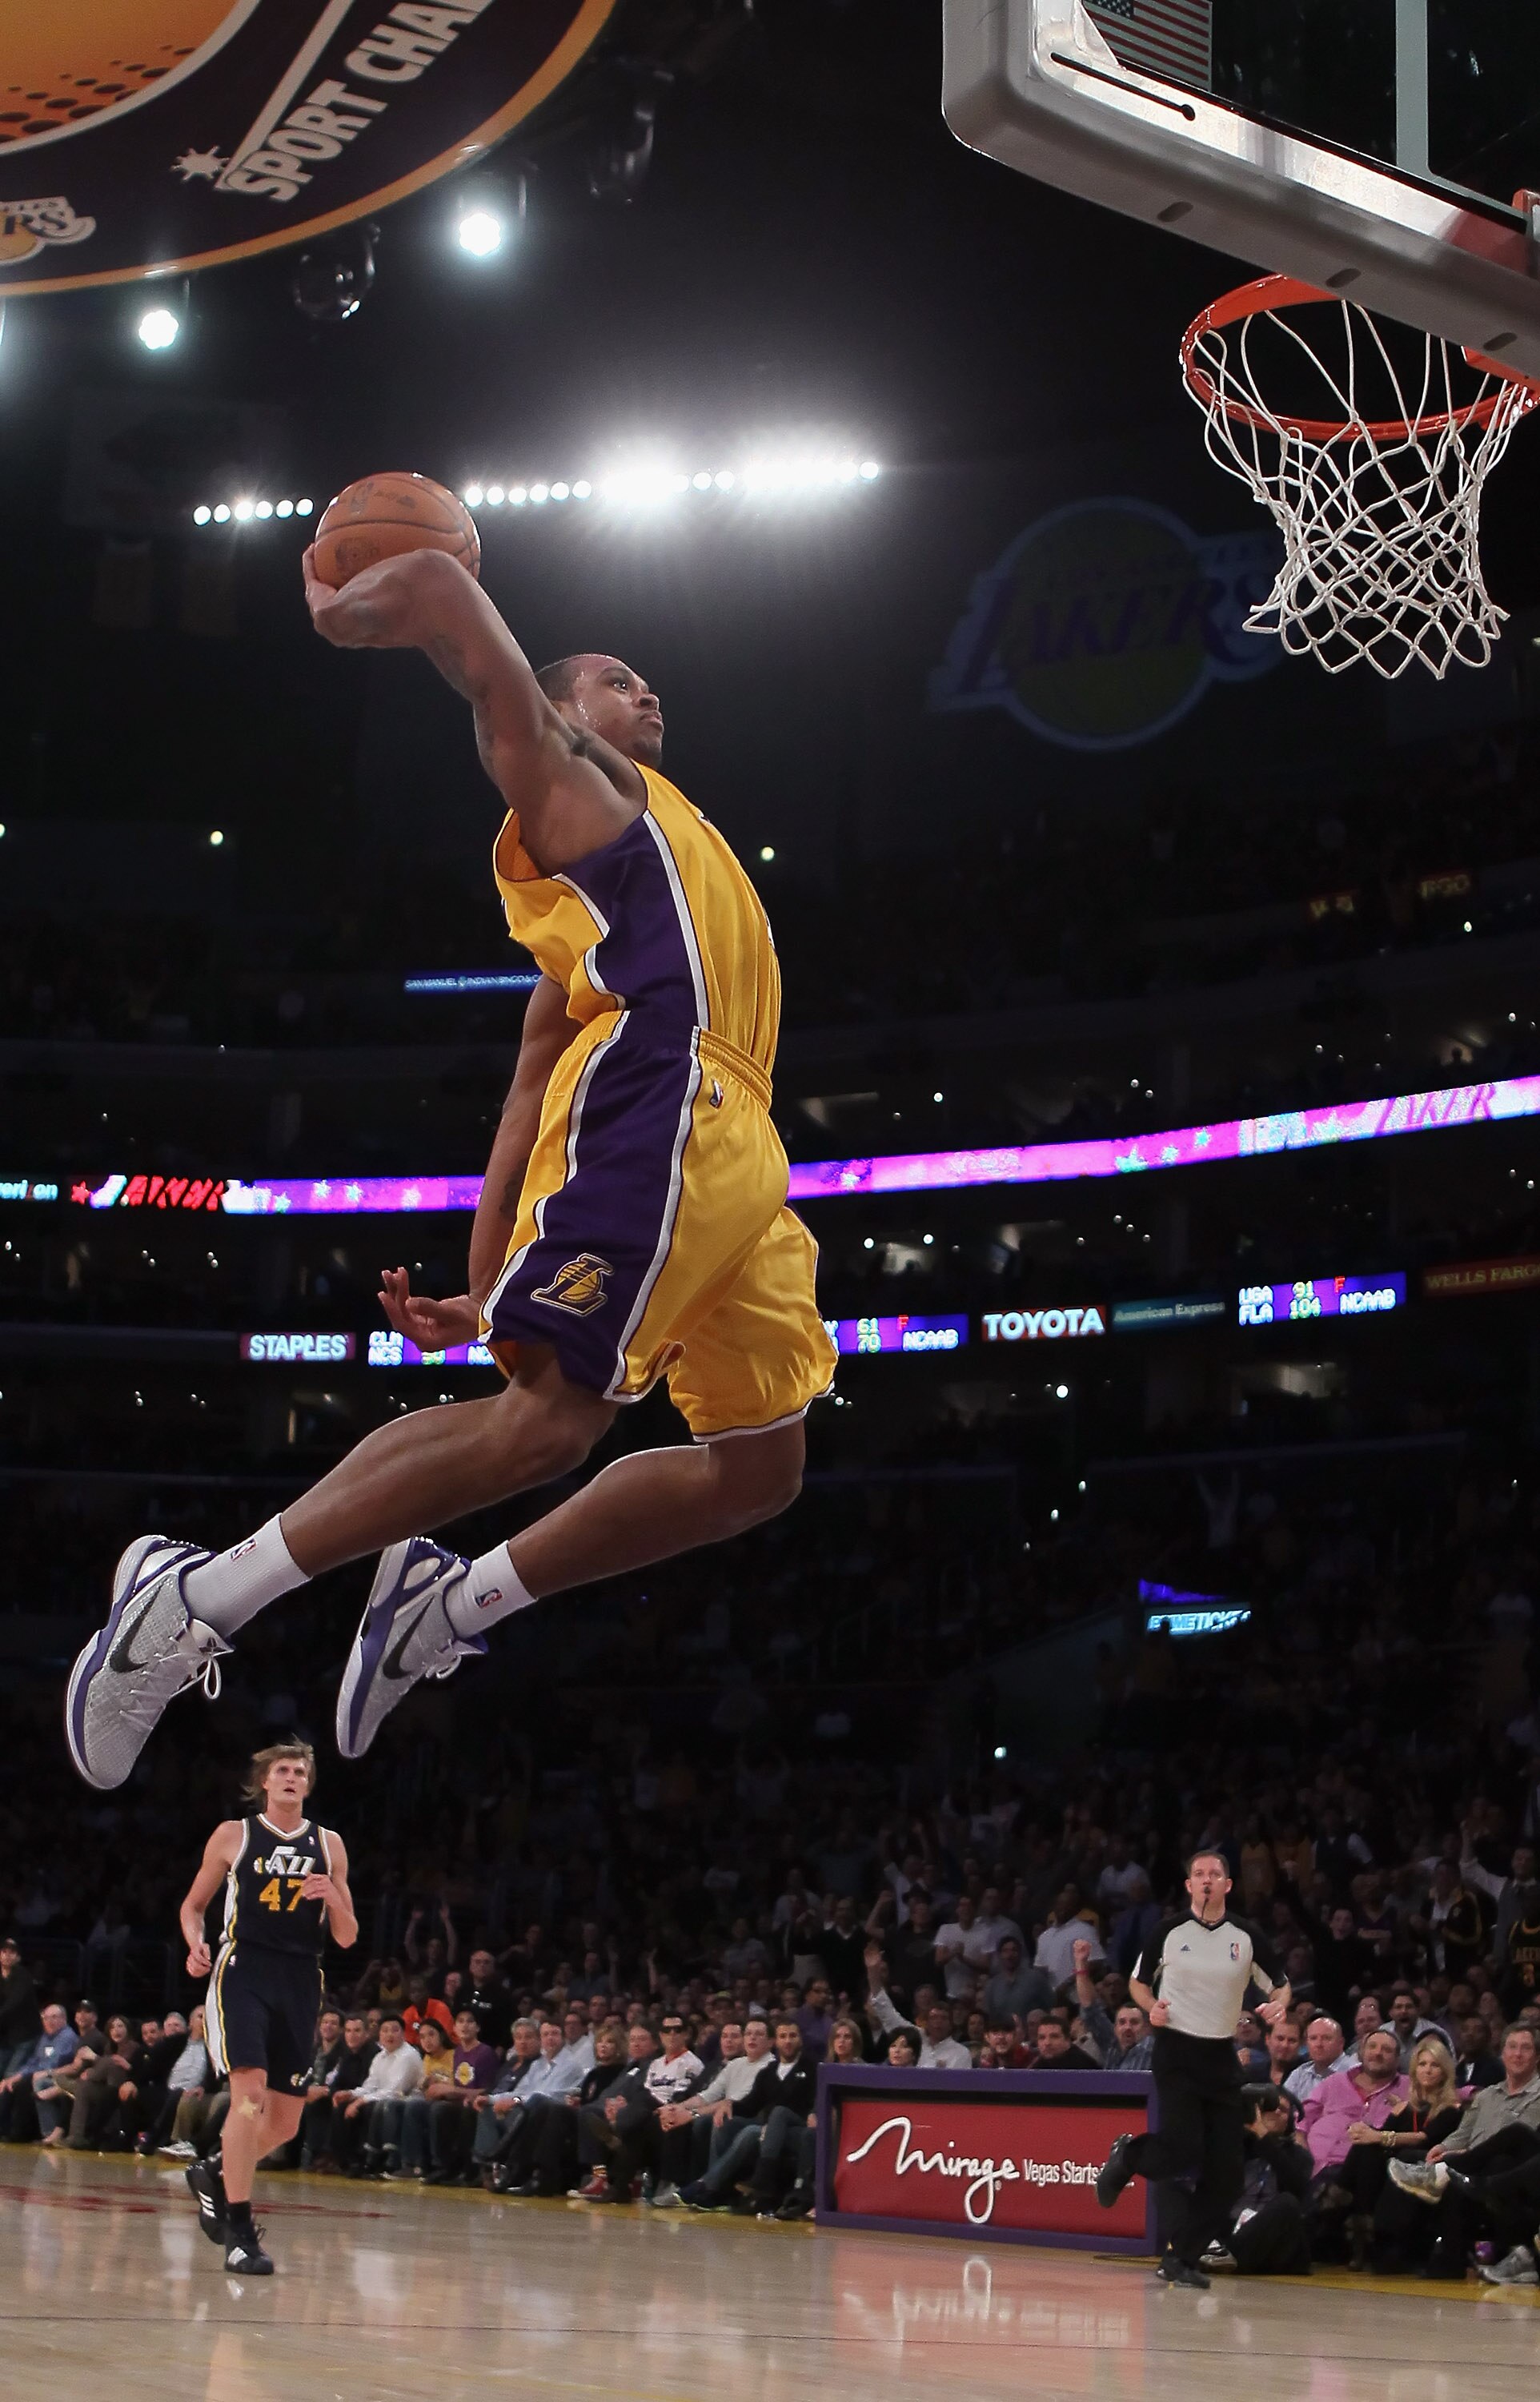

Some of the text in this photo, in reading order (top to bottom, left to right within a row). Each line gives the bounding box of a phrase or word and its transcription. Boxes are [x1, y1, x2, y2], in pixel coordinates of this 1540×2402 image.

[223, 0, 491, 203] SPORT CHA
[1238, 1277, 1346, 1306] UGA 91 F
[1427, 1269, 1485, 1288] WELLS
[1238, 1288, 1398, 1326] FLA 104 NCAAB
[896, 1315, 909, 1331] F
[984, 1308, 1107, 1341] TOYOTA
[248, 1333, 348, 1362] STAPLES
[902, 1328, 959, 1352] NCAAB
[259, 1877, 304, 1913] 47
[1023, 2158, 1061, 2188] Vegas
[1062, 2159, 1100, 2186] Starts
